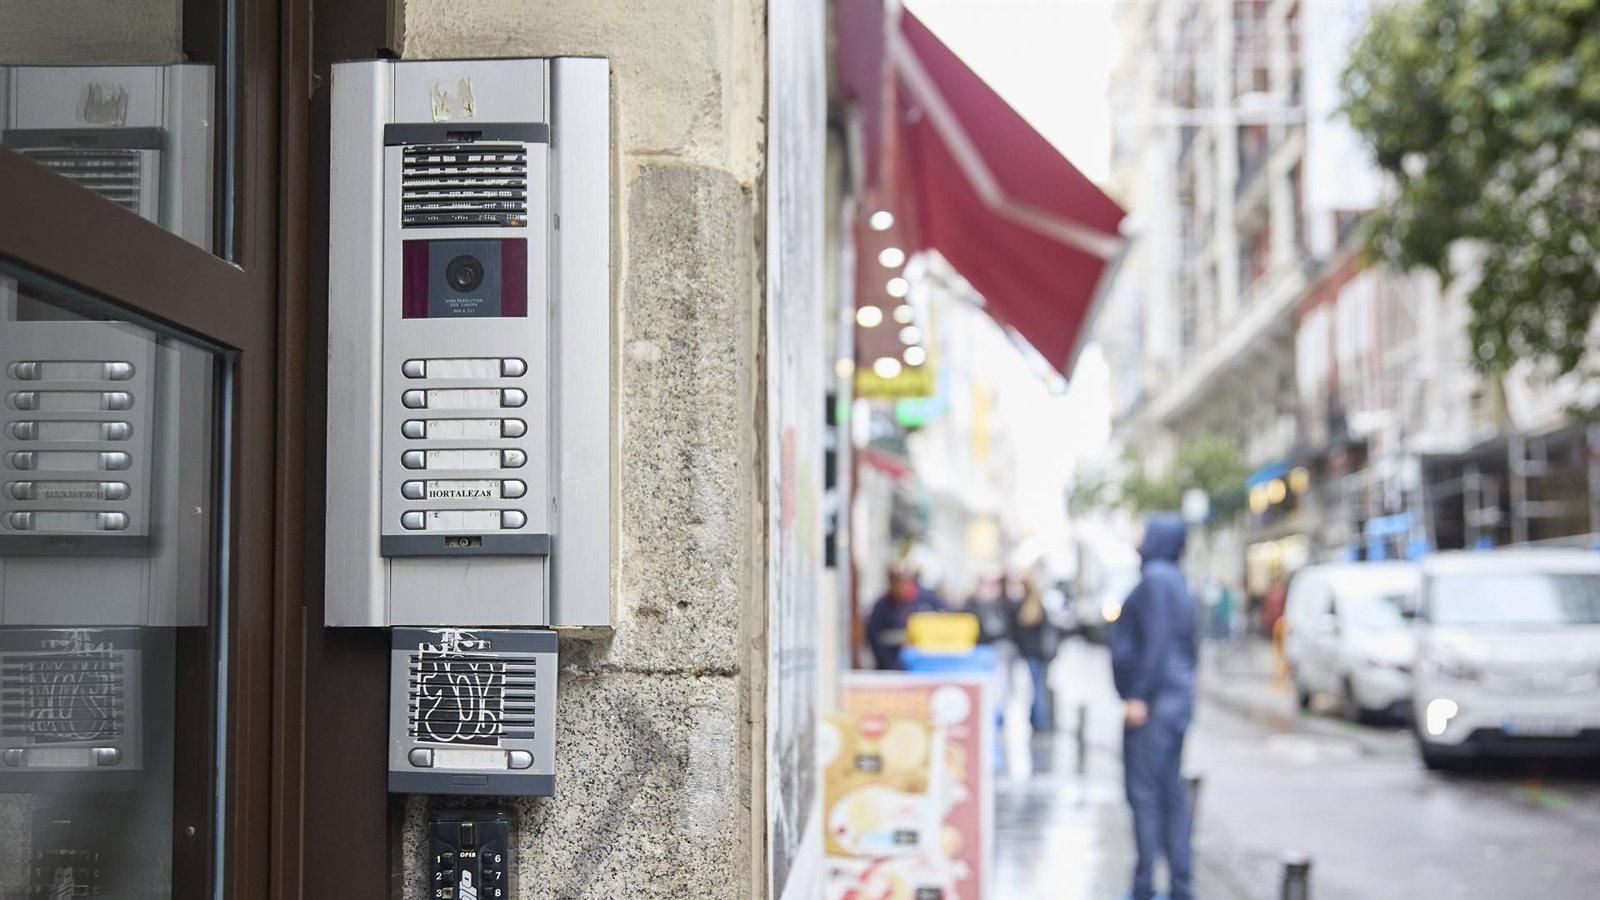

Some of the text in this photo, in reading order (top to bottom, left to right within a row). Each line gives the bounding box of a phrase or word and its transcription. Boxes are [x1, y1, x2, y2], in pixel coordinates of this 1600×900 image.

[437, 855, 441, 863] 1
[494, 855, 501, 863] 6
[436, 872, 442, 880] 2
[495, 872, 501, 880] 7
[436, 889, 442, 897] 3
[494, 889, 501, 897] 8
